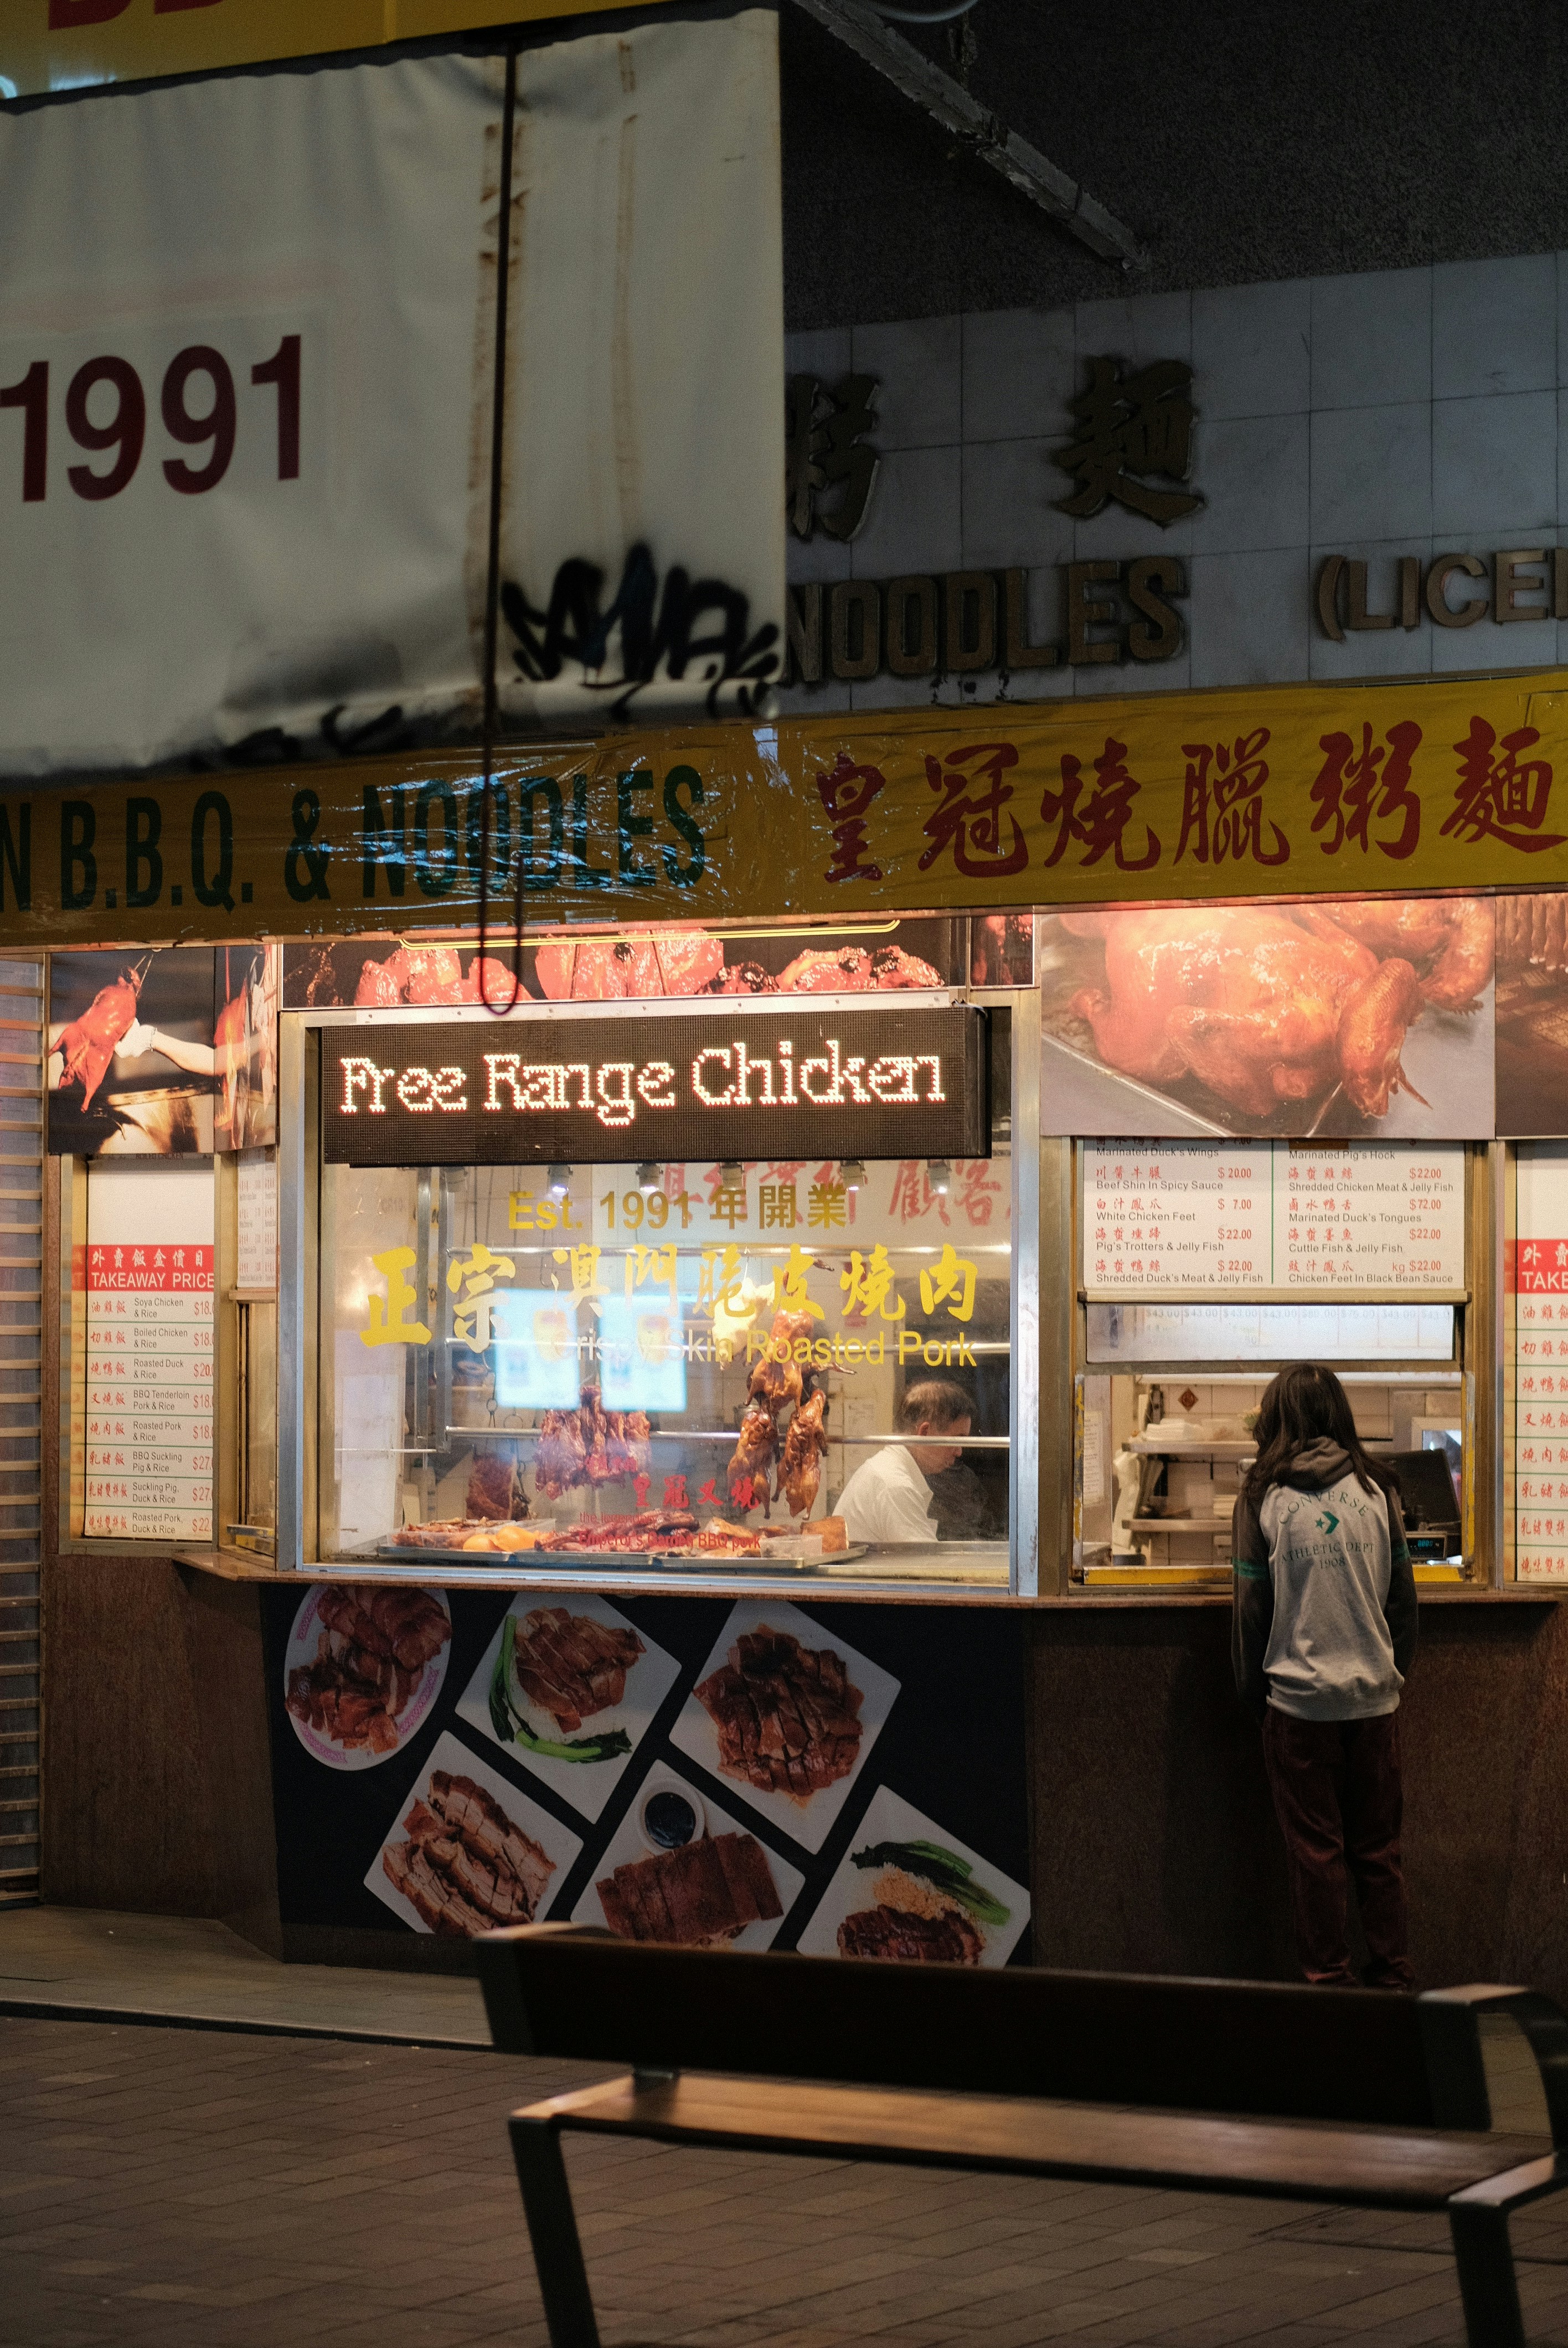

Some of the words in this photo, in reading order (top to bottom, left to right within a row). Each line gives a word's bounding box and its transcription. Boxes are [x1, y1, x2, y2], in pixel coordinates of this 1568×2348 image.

[0, 334, 301, 502] 1991
[784, 555, 1188, 684] NOODLES
[60, 790, 254, 914] B.B.Q.
[285, 789, 332, 903] &
[362, 765, 705, 898] NOODLES
[340, 1056, 467, 1113] Free
[482, 1053, 677, 1127] Range
[692, 1039, 947, 1106] Chicken
[1096, 1147, 1147, 1157] Marinated
[1151, 1147, 1184, 1157] Duck's
[1188, 1148, 1219, 1158] Wings
[1289, 1150, 1339, 1160] Marinated
[1343, 1150, 1367, 1161] Pig's
[1370, 1151, 1395, 1160] Hock
[1096, 1181, 1120, 1190] Beef
[1123, 1181, 1145, 1190] Shin
[1148, 1181, 1158, 1190] In
[1160, 1181, 1188, 1191] Spicy
[1192, 1181, 1223, 1190] Sauce
[1289, 1182, 1334, 1191] Shredded
[1337, 1182, 1374, 1191] Chicken
[1376, 1183, 1399, 1191] Meat
[1401, 1183, 1407, 1191] &
[1410, 1183, 1431, 1193] Jelly
[1435, 1183, 1453, 1192] Fish
[508, 1190, 583, 1230] Est.
[600, 1190, 689, 1230] 1991
[709, 1183, 848, 1230] 年開業
[1096, 1212, 1126, 1221] White
[1129, 1212, 1169, 1221] Chicken
[1173, 1212, 1195, 1221] Feet
[1289, 1213, 1339, 1222] Marinated
[1343, 1213, 1376, 1222] Duck's
[1379, 1213, 1421, 1223] Tongues
[1096, 1242, 1121, 1253] Pig's
[1124, 1242, 1163, 1251] Trotters
[1167, 1242, 1173, 1251] &
[1177, 1242, 1199, 1253] Jelly
[1203, 1242, 1224, 1251] Fish
[1289, 1244, 1319, 1253] Cuttle
[1322, 1244, 1343, 1253] Fish
[1346, 1244, 1352, 1253] &
[1356, 1244, 1378, 1254] Jelly
[1381, 1244, 1402, 1253] Fish
[1392, 1261, 1405, 1274] kg
[91, 1272, 166, 1288] TAKEAWAY
[1096, 1273, 1143, 1283] Shredded
[1147, 1273, 1179, 1283] Duck's
[1182, 1274, 1206, 1283] Meat
[1209, 1274, 1215, 1283] &
[1218, 1274, 1240, 1284] Jelly
[1242, 1274, 1263, 1283] Fish
[1289, 1274, 1328, 1283] Chicken
[1331, 1274, 1352, 1283] Feet
[1355, 1274, 1363, 1283] In
[1366, 1274, 1392, 1283] Black
[1396, 1274, 1420, 1283] Bean
[1423, 1274, 1453, 1283] Sauce
[135, 1297, 152, 1308] Soya
[154, 1298, 184, 1307] Chicken
[135, 1309, 139, 1318] &
[141, 1309, 157, 1318] Rice
[134, 1329, 157, 1337] Boiled
[159, 1329, 188, 1337] Chicken
[134, 1340, 138, 1348] &
[141, 1340, 157, 1348] Rice
[667, 1329, 733, 1363] Skin
[746, 1329, 884, 1365] Roasted
[899, 1331, 977, 1367] Pork
[134, 1358, 163, 1367] Roasted
[166, 1359, 184, 1368] Duck
[134, 1370, 138, 1378] &
[141, 1371, 157, 1379] Rice
[133, 1389, 149, 1399] BBQ
[152, 1390, 189, 1399] Tenderloin
[133, 1402, 149, 1410] Pork
[152, 1402, 156, 1410] &
[159, 1402, 175, 1410] Rice
[133, 1421, 163, 1430] Roasted
[166, 1422, 182, 1430] Pork
[133, 1433, 138, 1441] &
[140, 1433, 156, 1441] Rice
[133, 1451, 149, 1460] BBQ
[151, 1452, 182, 1463] Suckling
[133, 1463, 145, 1473] Pig
[146, 1464, 151, 1472] &
[153, 1464, 169, 1472] Rice
[193, 1456, 213, 1471] $27.
[132, 1482, 163, 1493] Suckling
[132, 1494, 150, 1502] Duck
[152, 1495, 157, 1503] &
[159, 1495, 176, 1503] Rice
[193, 1486, 213, 1502] $27.
[1278, 1490, 1369, 1525] CONVERSE
[132, 1513, 162, 1522] Roasted
[132, 1525, 150, 1533] Duck
[152, 1525, 157, 1533] &
[159, 1525, 175, 1534] Rice
[698, 1533, 728, 1549] BBQ
[732, 1535, 761, 1552] pork
[1281, 1541, 1340, 1563] ATHLETIC
[1345, 1541, 1375, 1554] DEPT
[1320, 1557, 1345, 1569] 1908
